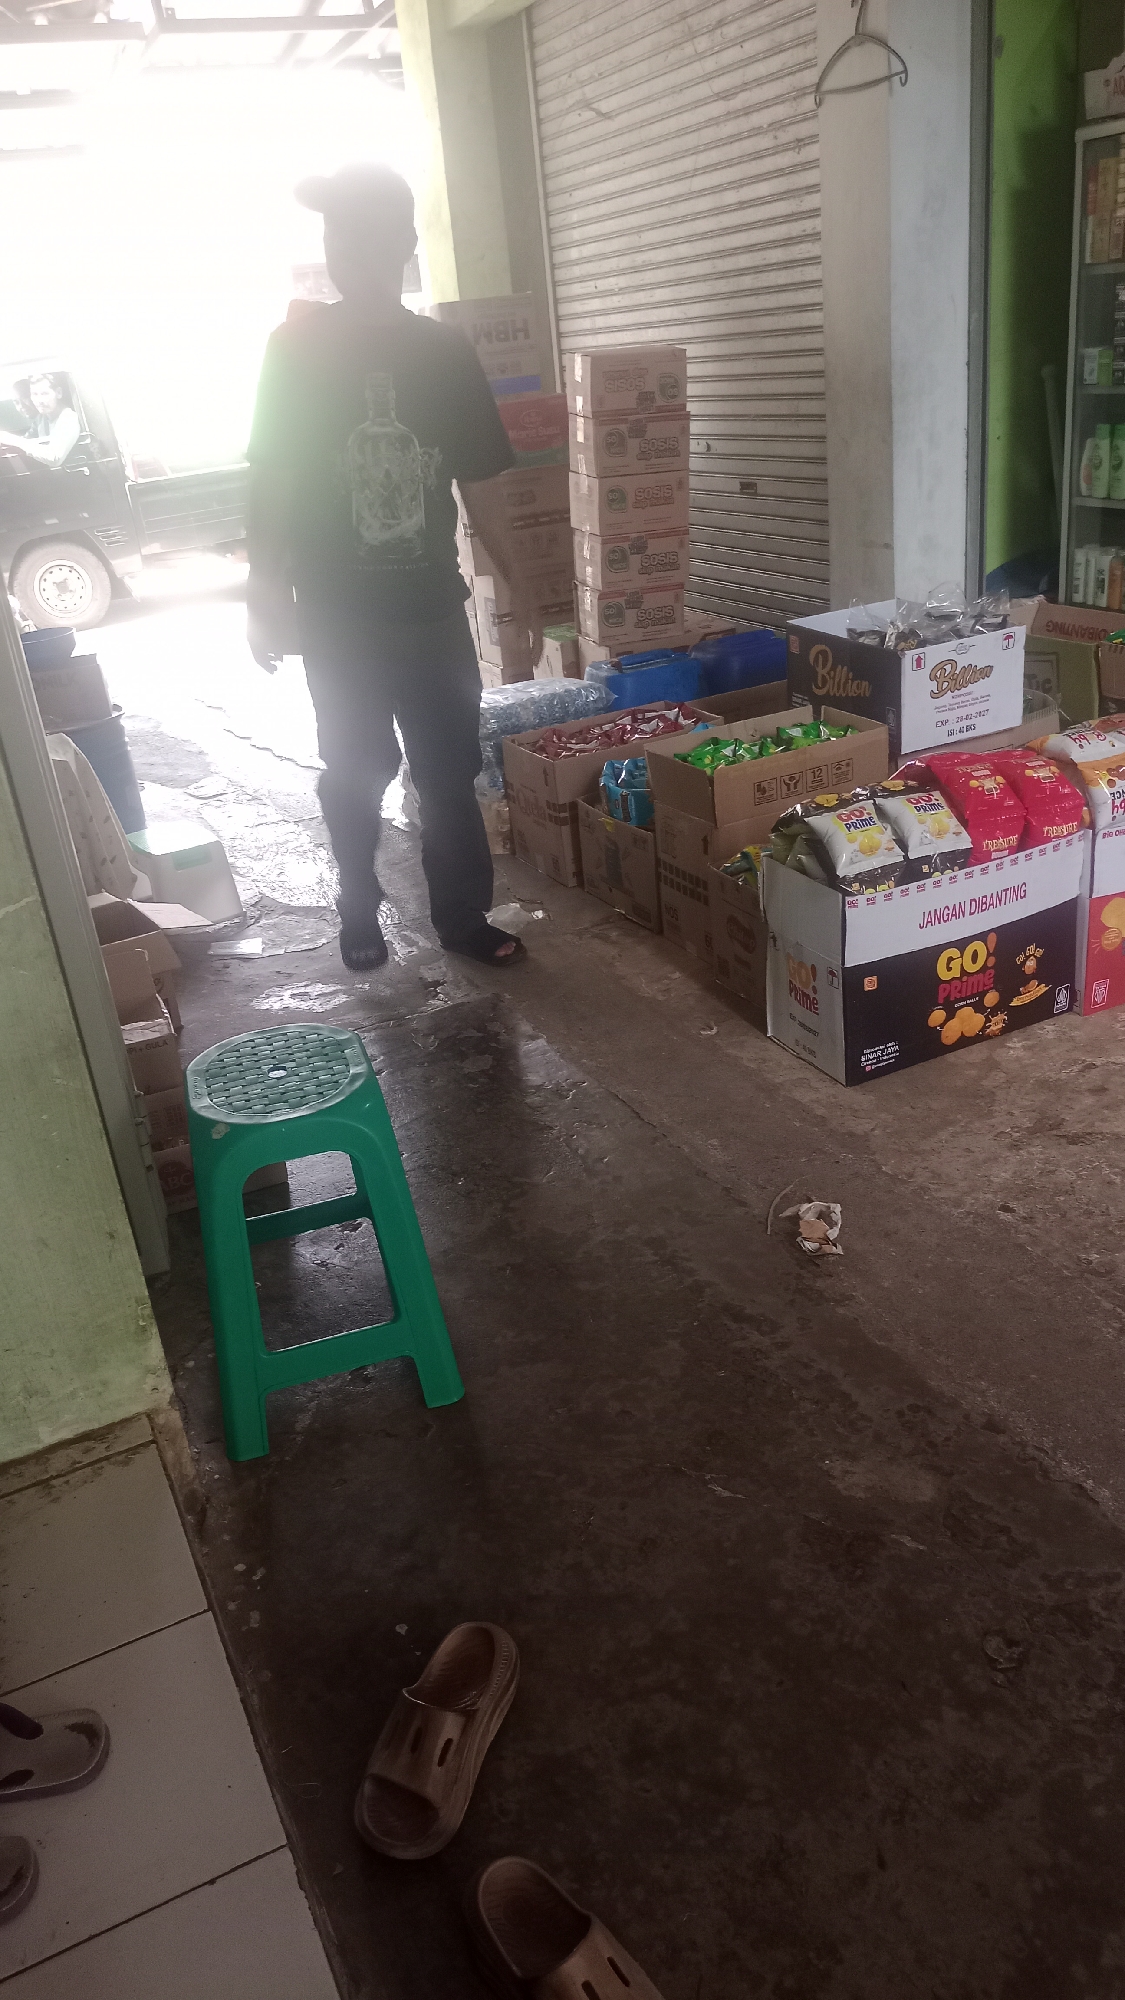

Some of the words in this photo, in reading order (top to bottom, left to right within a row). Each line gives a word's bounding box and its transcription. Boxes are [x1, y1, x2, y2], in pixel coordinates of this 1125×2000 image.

[605, 377, 645, 393] SOSIS
[638, 436, 679, 453] SOSIS
[635, 485, 673, 501] SOSIS
[641, 551, 679, 567] SOSIS
[636, 605, 675, 621] SOSIS
[809, 644, 872, 697] Billion
[929, 659, 994, 699] Billion
[811, 767, 823, 780] 12
[906, 793, 940, 806] GO!
[836, 806, 872, 823] GO!
[982, 834, 1018, 851] TREASURE
[919, 901, 966, 930] JANGAN
[969, 882, 1027, 916] DIBANTING
[937, 932, 997, 981] GO!
[786, 952, 818, 996] GO!
[145, 1039, 169, 1051] GULA
[861, 1051, 881, 1061] SINAR
[883, 1045, 899, 1055] JAYA
